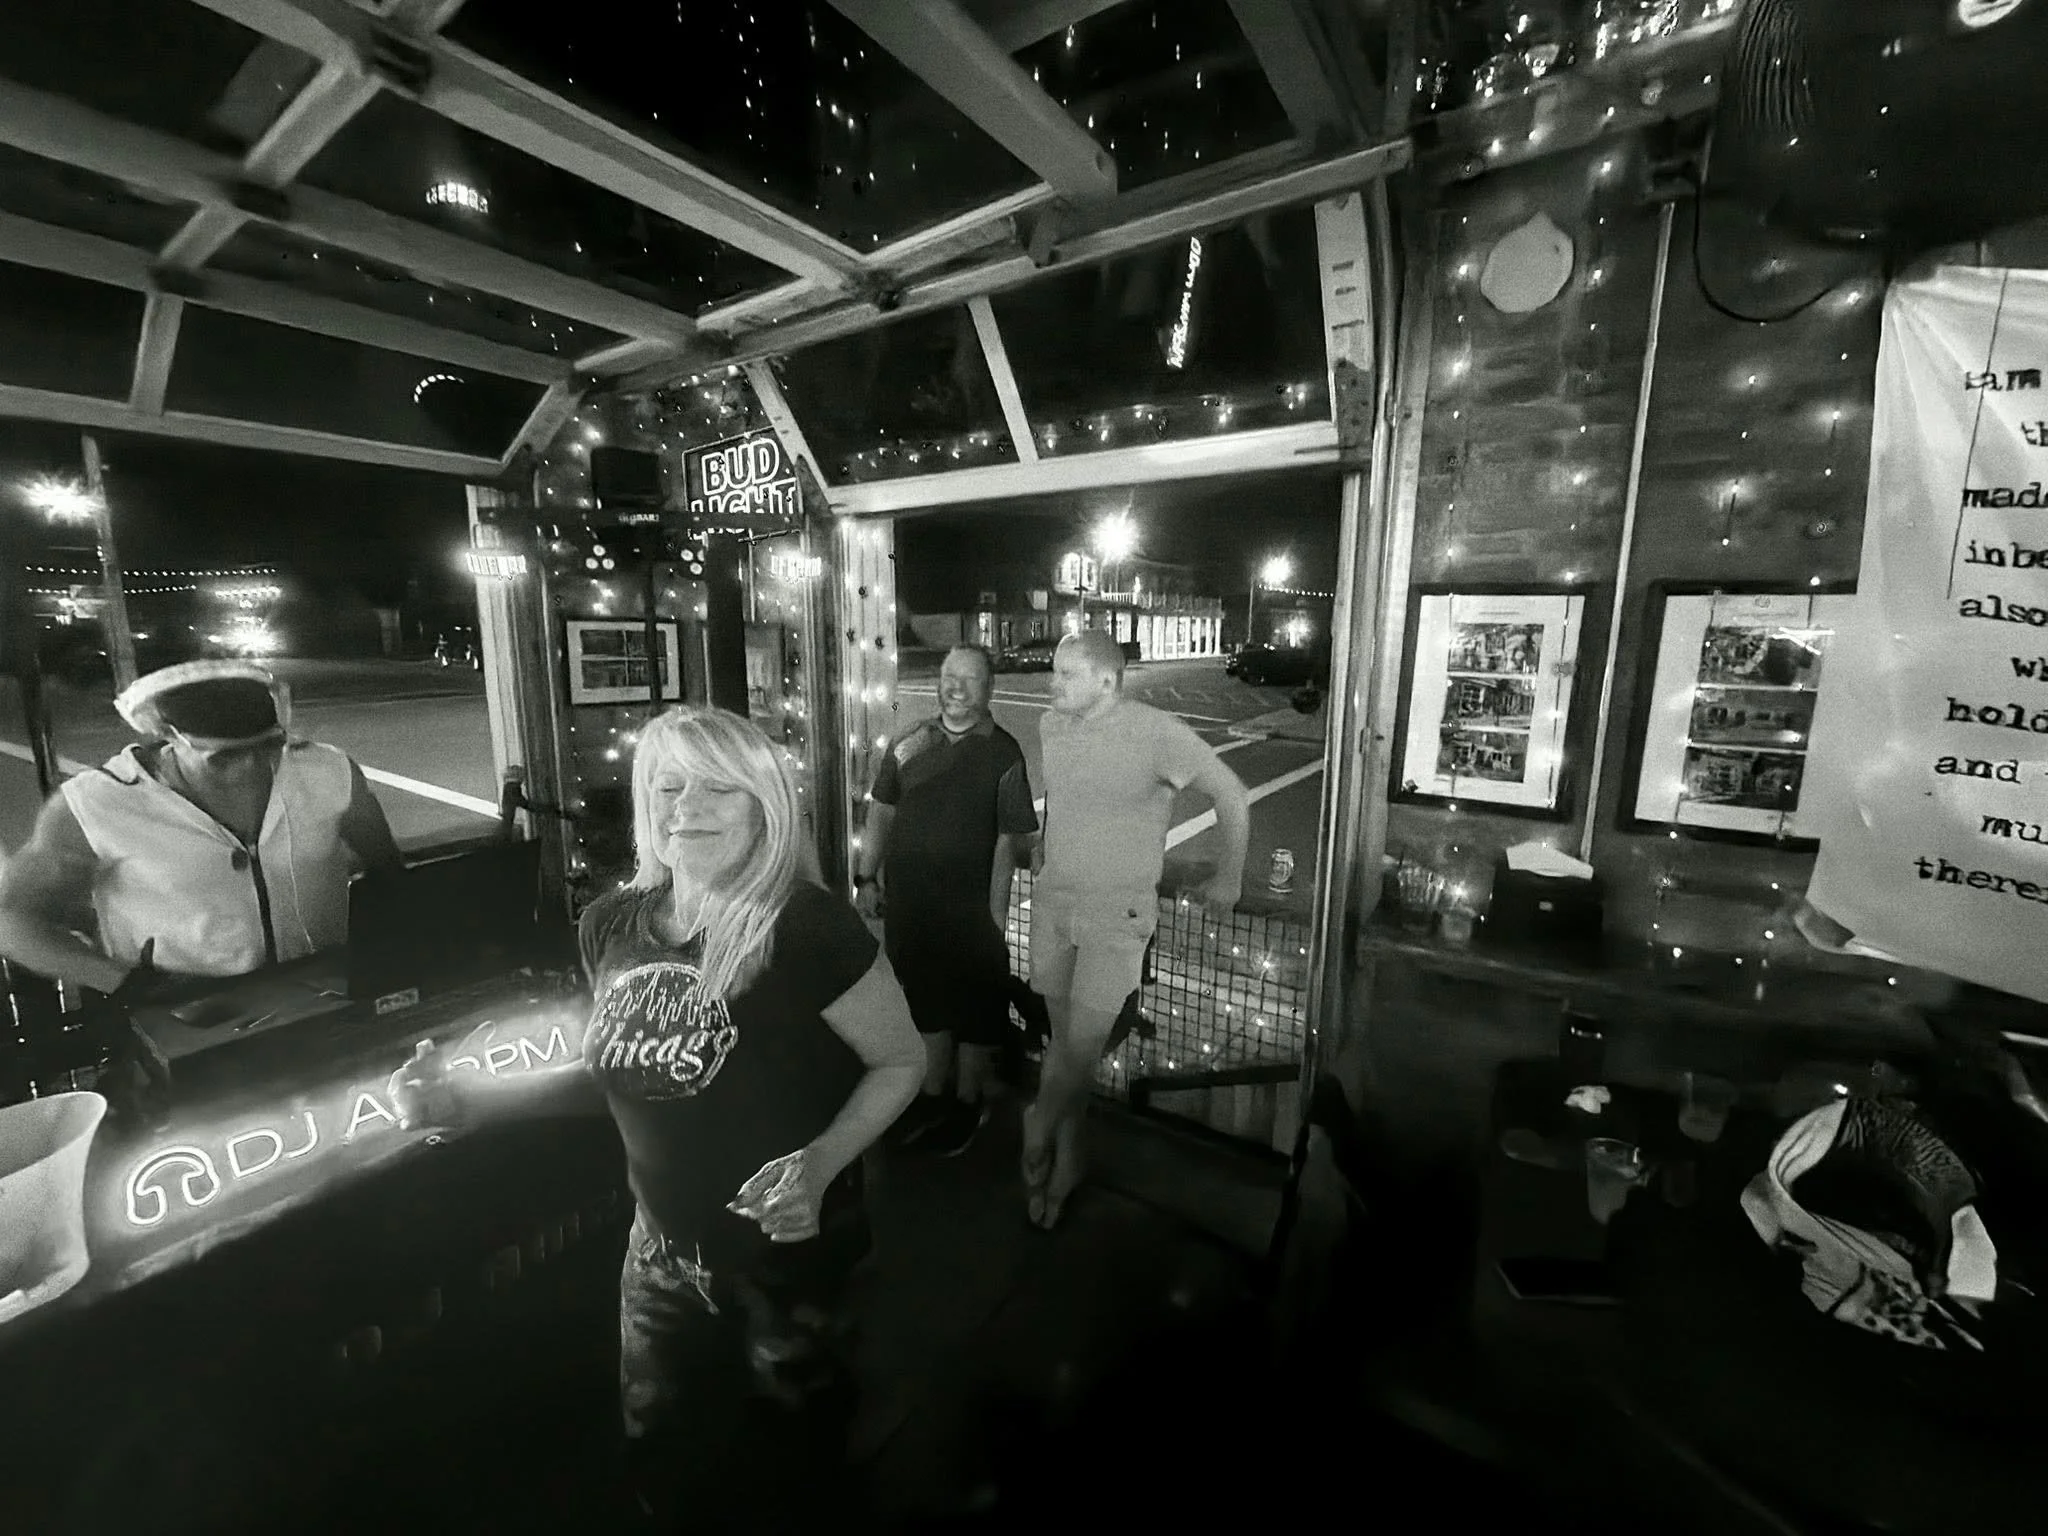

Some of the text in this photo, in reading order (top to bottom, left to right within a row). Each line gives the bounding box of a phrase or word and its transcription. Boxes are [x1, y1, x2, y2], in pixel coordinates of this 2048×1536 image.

[701, 438, 780, 495] BUD
[1962, 481, 2048, 509] mad
[1959, 594, 2048, 628] also
[1934, 756, 2021, 784] and
[1913, 856, 2048, 905] there
[226, 1110, 319, 1179] DJ
[345, 1092, 399, 1142] A
